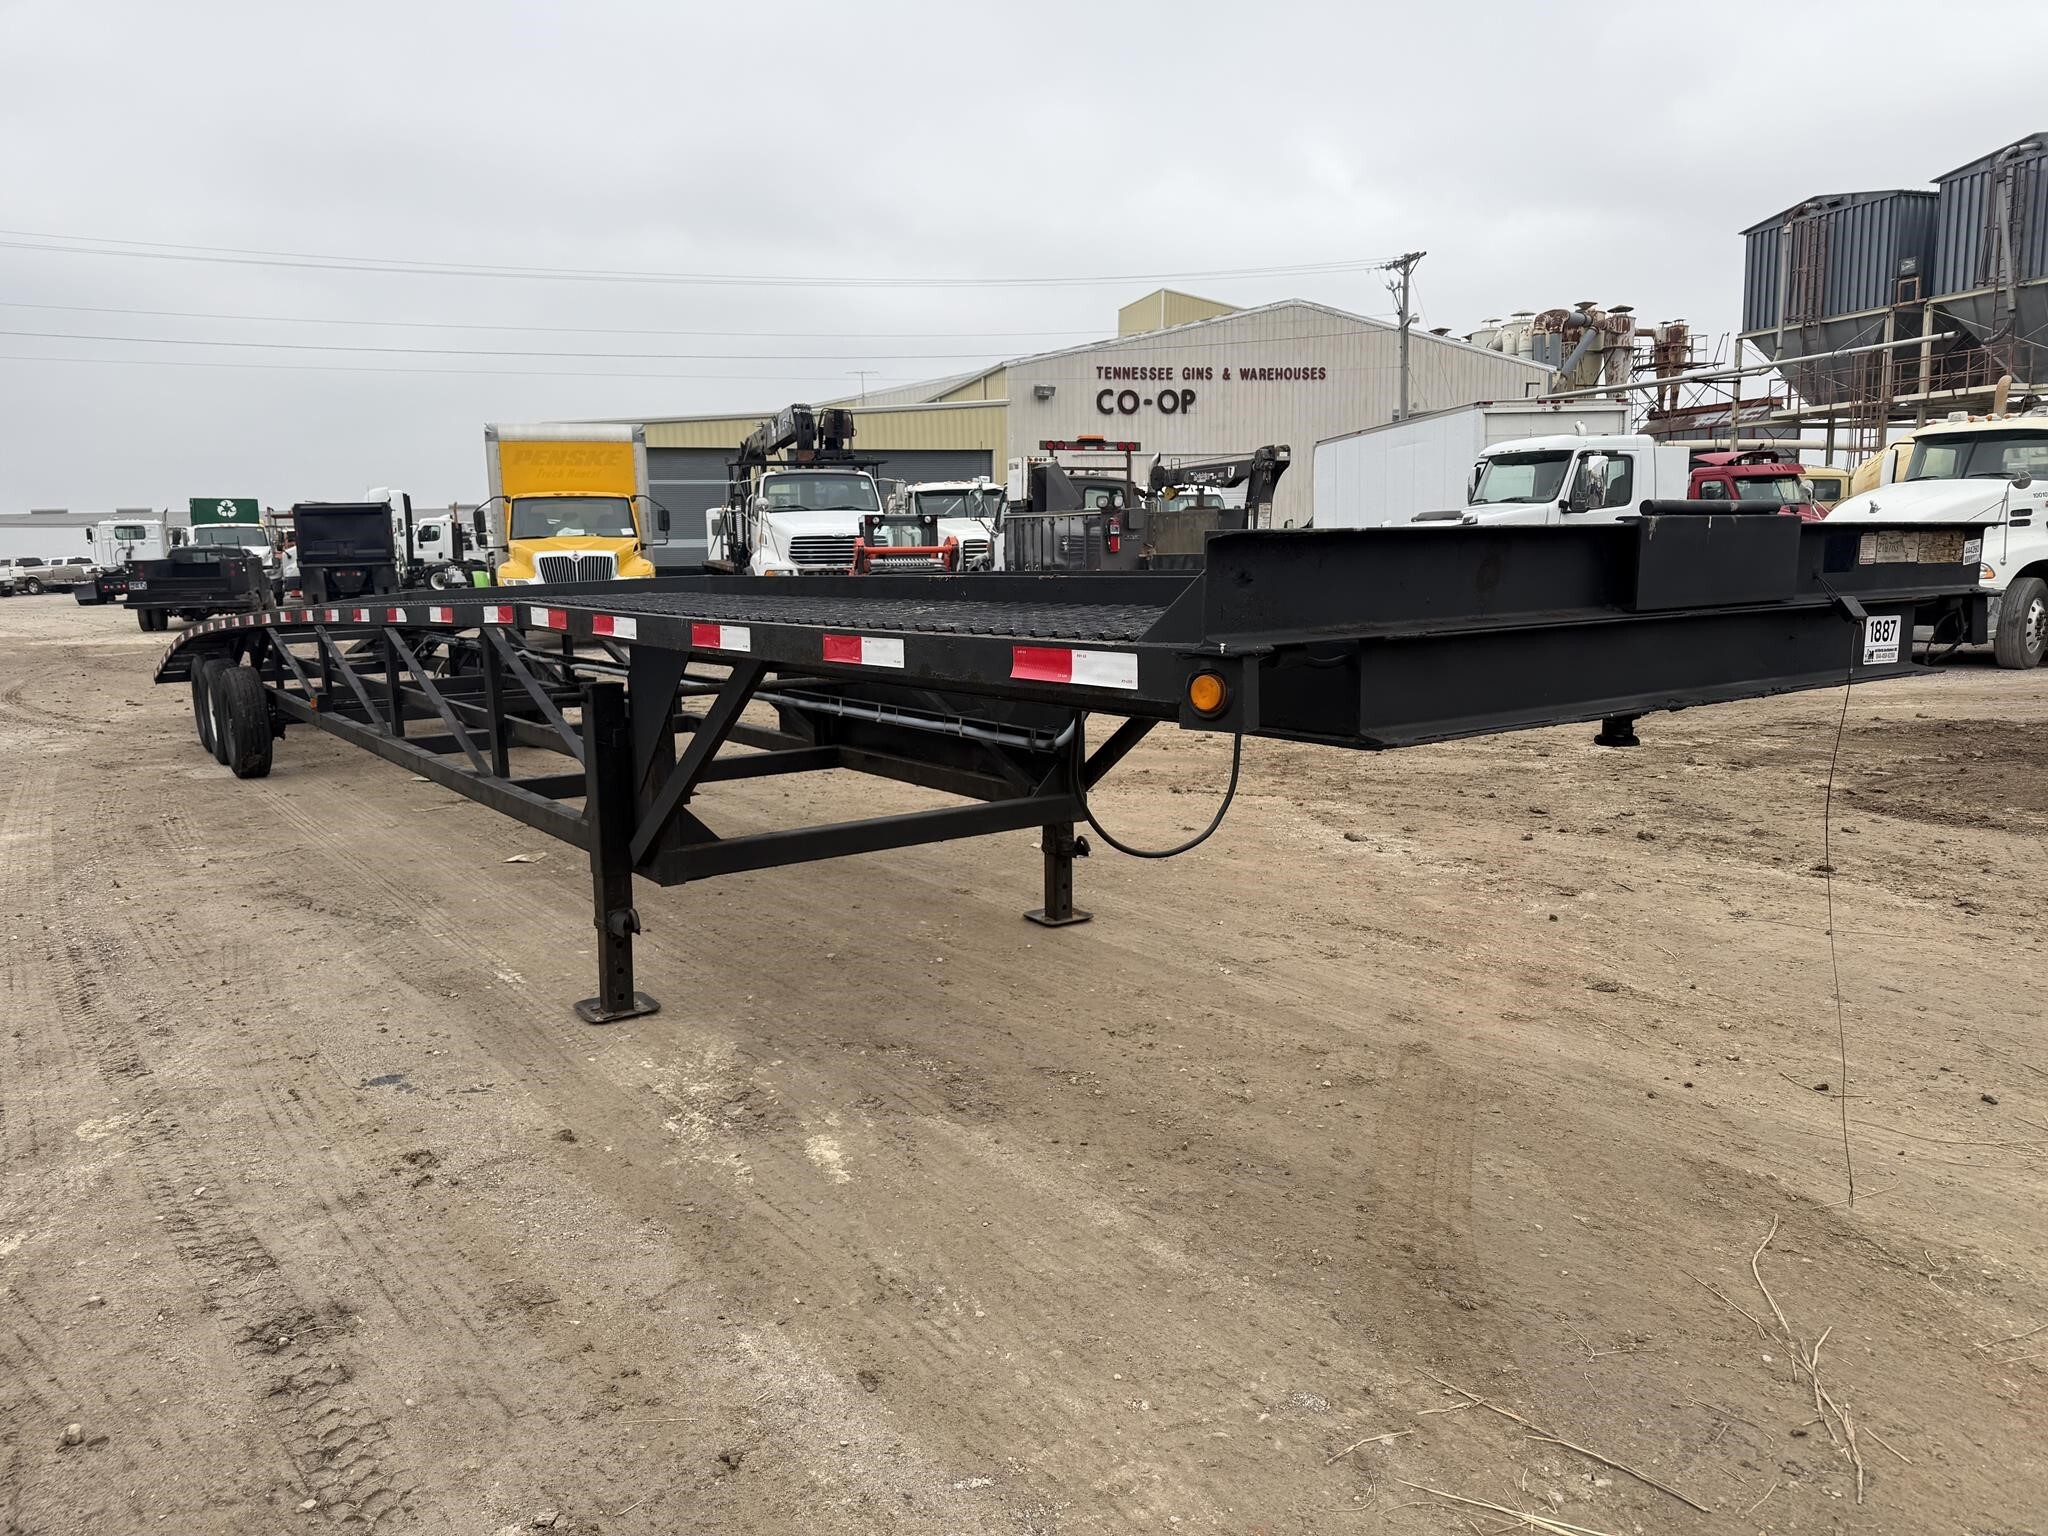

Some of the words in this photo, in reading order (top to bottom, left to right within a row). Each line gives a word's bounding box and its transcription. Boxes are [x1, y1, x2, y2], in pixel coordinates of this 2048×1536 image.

[1096, 366, 1174, 380] TENNESSEE
[1182, 367, 1213, 380] GINS
[1222, 367, 1231, 380] &
[1240, 367, 1327, 380] WAREHOUSES
[1096, 388, 1196, 415] CO-OP
[514, 449, 623, 466] PENSKE
[537, 468, 562, 479] Truck
[1870, 620, 1897, 642] 1887
